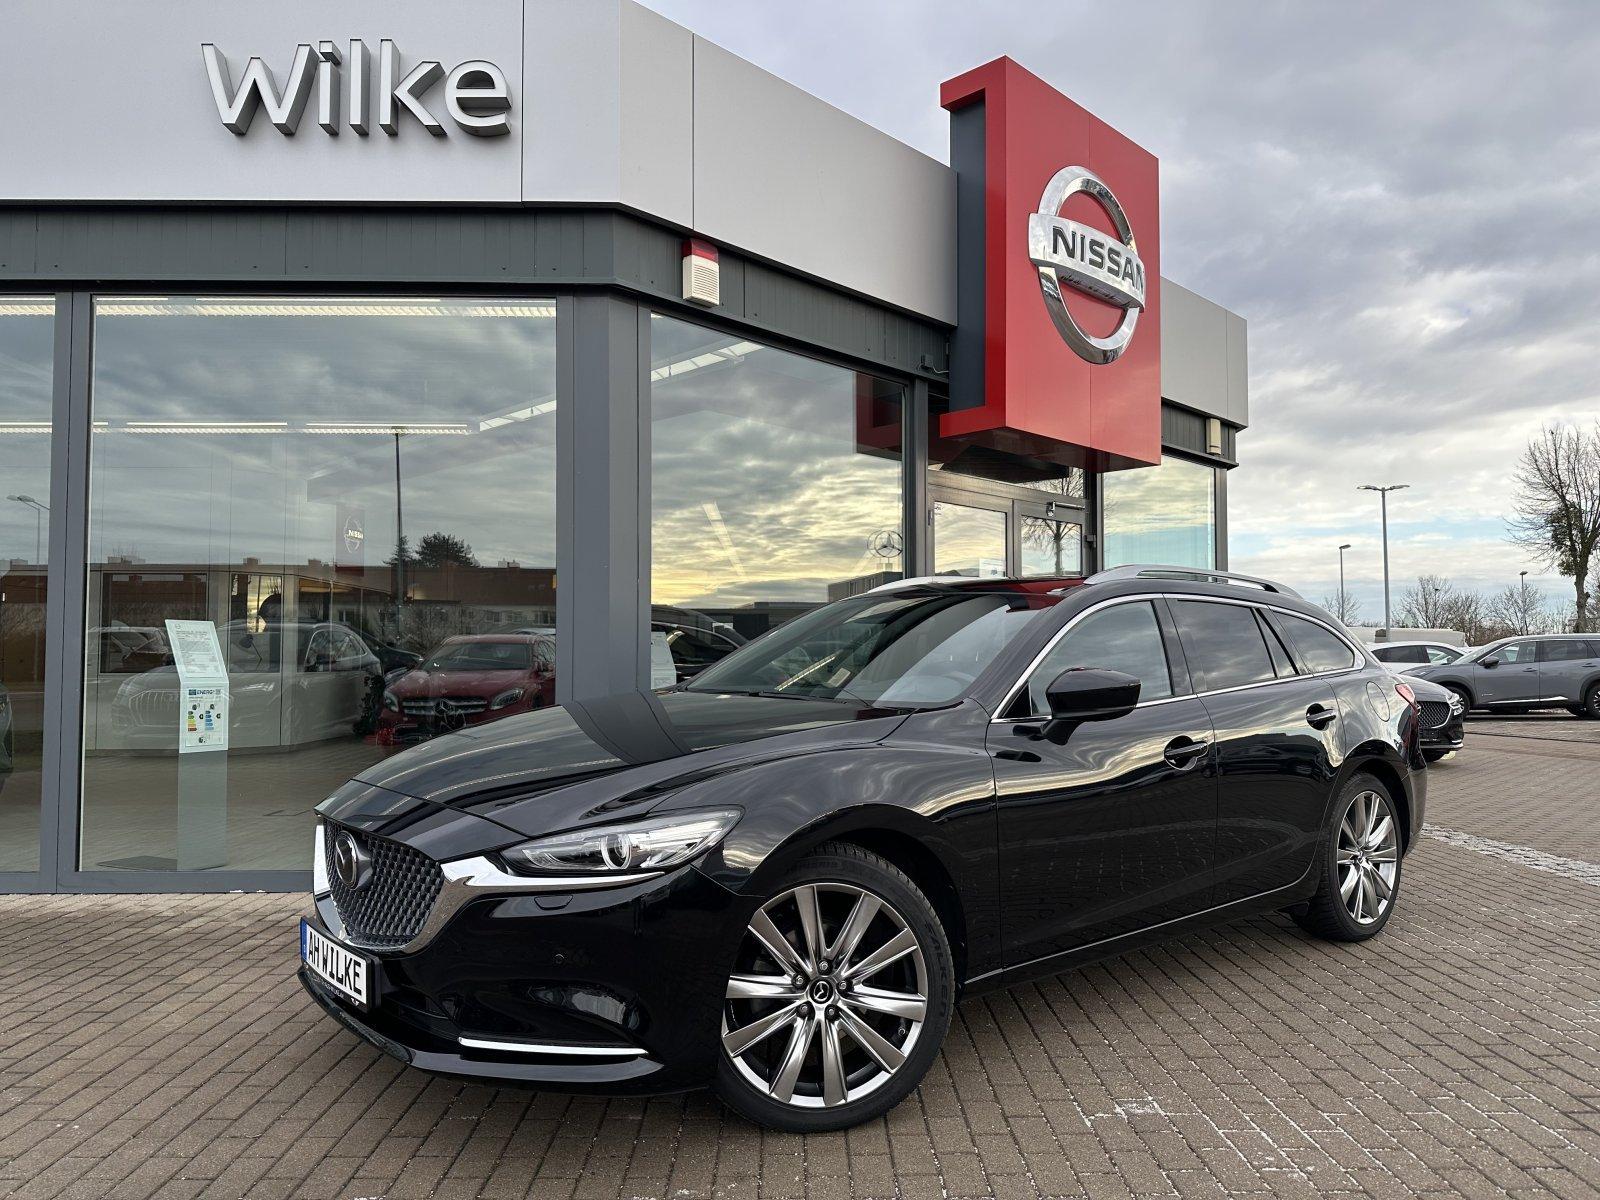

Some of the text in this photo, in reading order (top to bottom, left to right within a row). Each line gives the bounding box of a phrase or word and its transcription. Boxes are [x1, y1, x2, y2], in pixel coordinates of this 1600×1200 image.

[201, 38, 512, 138] Wilke
[1052, 226, 1144, 294] NISSAN
[308, 931, 320, 968] AH
[322, 940, 362, 996] WILKE
[924, 919, 948, 1018] FALKEN
